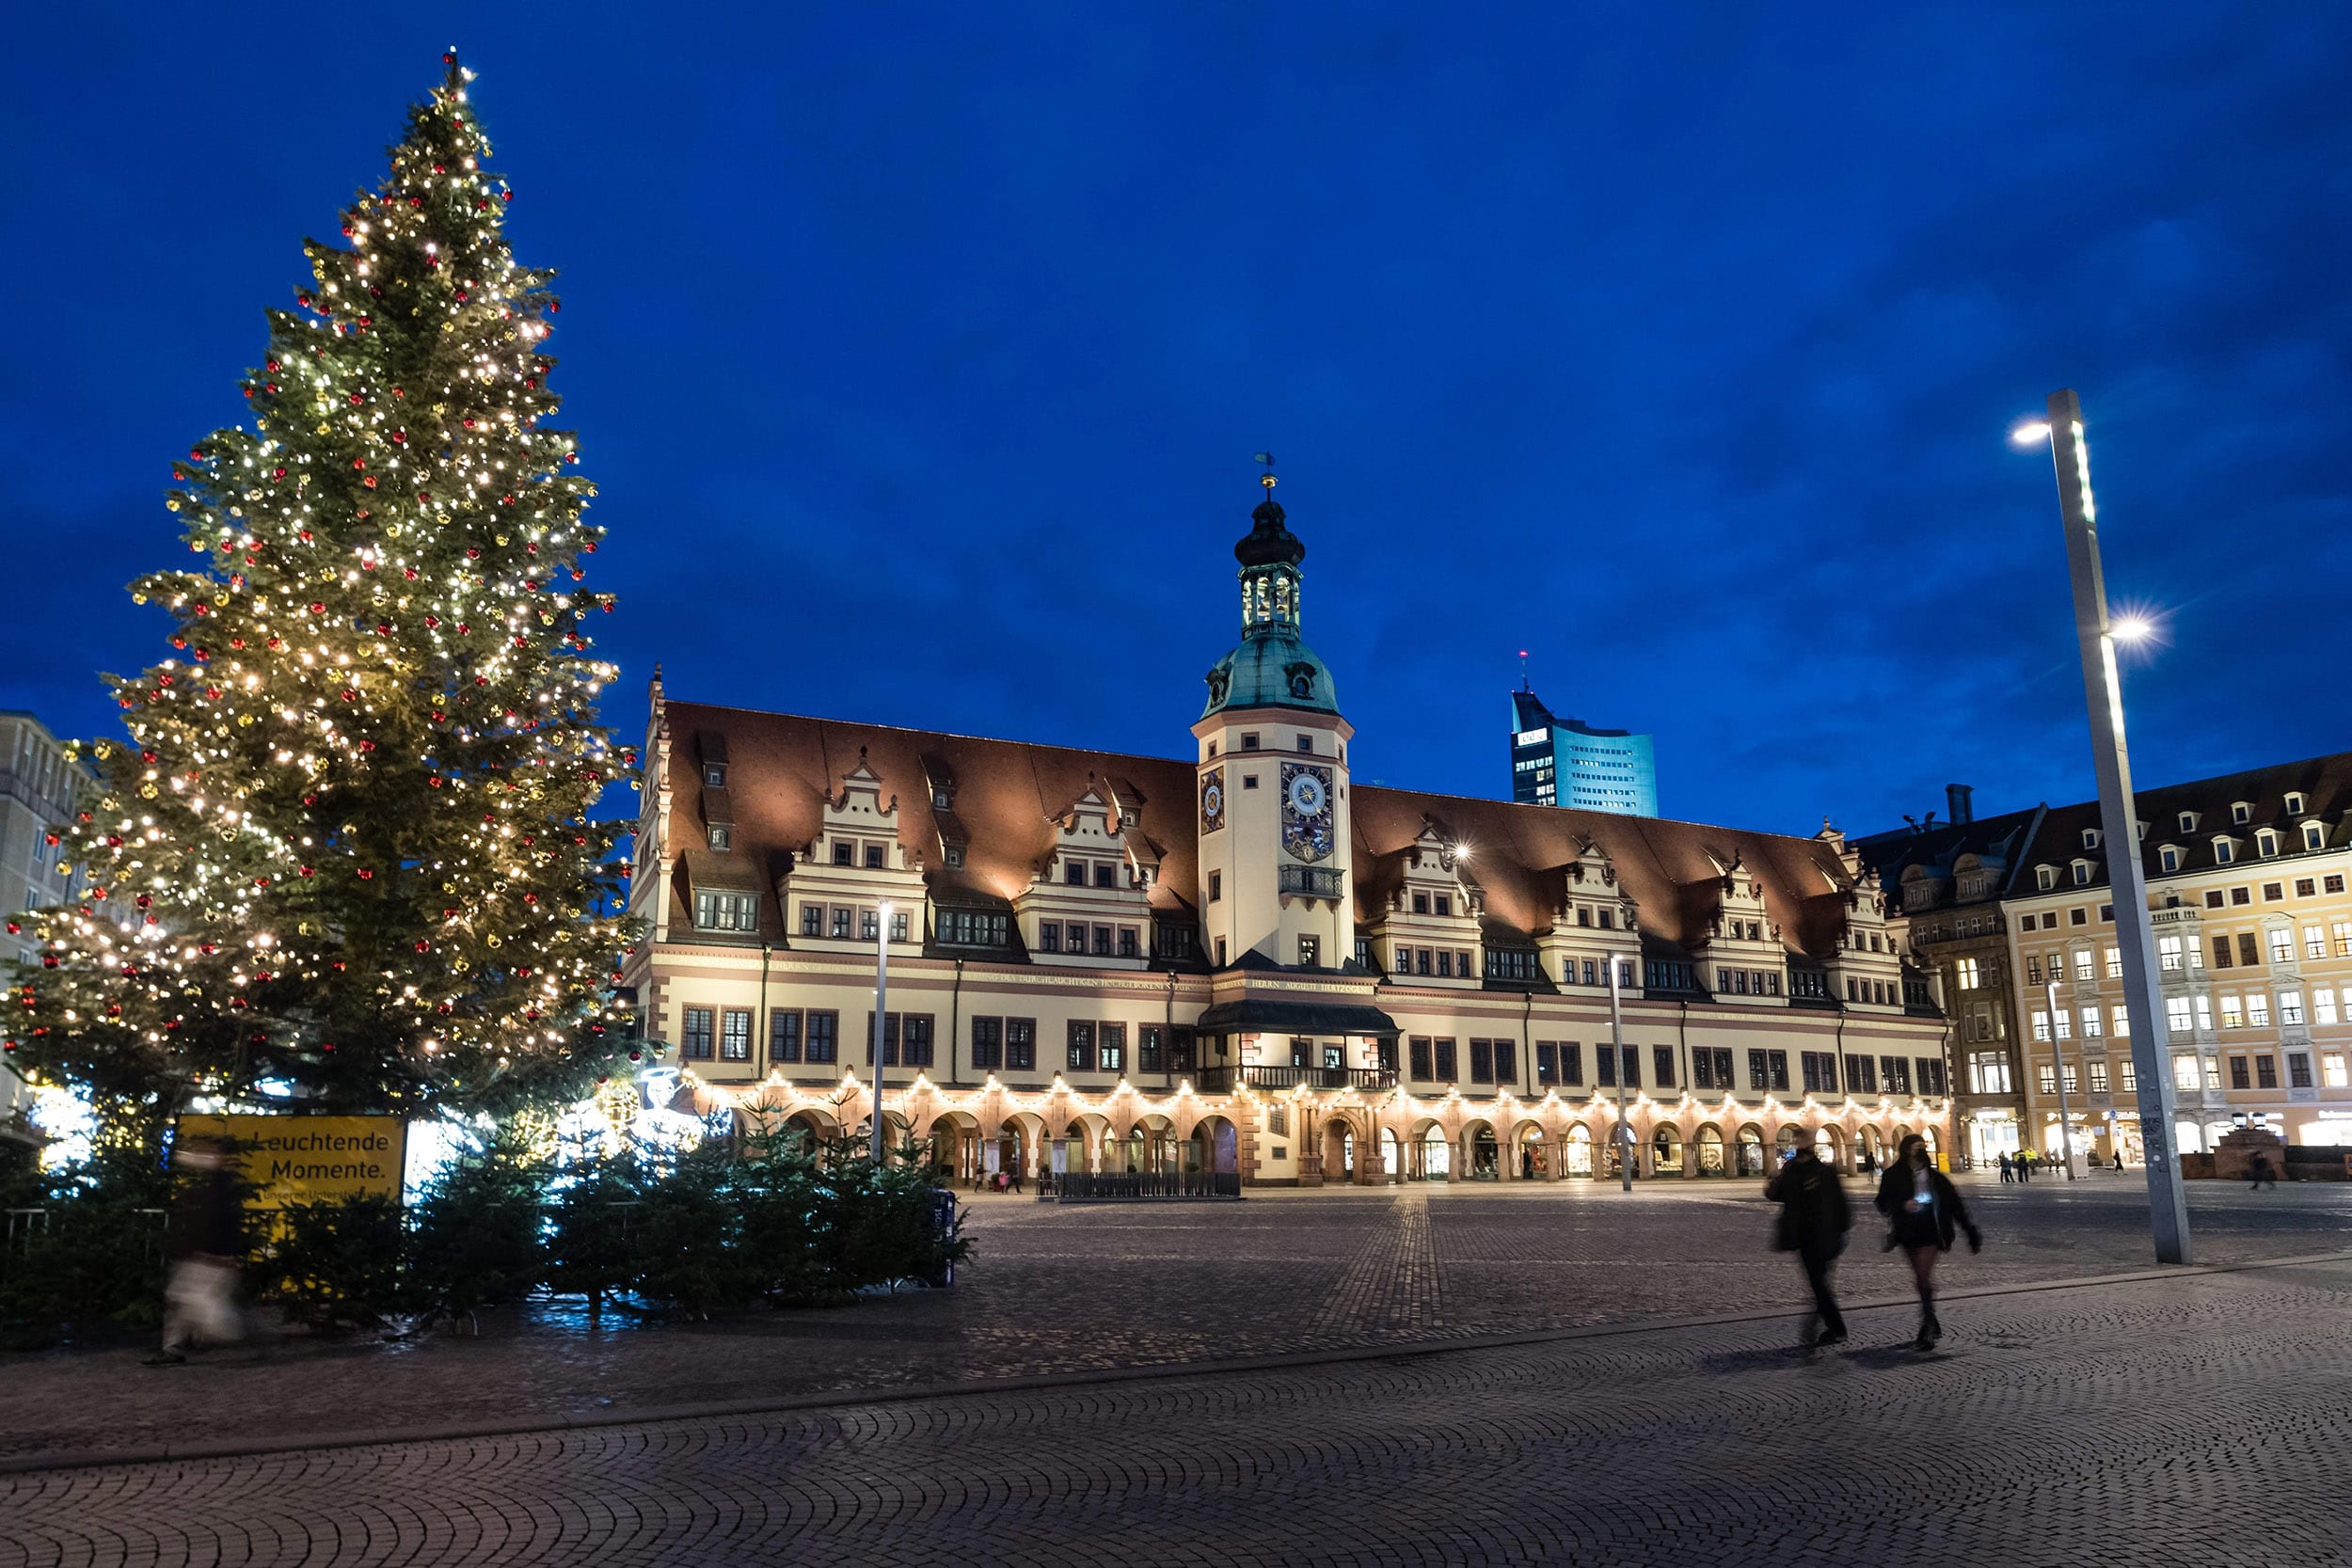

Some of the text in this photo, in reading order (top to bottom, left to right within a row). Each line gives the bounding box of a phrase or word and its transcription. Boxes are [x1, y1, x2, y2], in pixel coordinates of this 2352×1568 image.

[1251, 979, 1279, 989] HERRN
[253, 1132, 389, 1151] Leuchtende
[271, 1159, 386, 1179] Momente.
